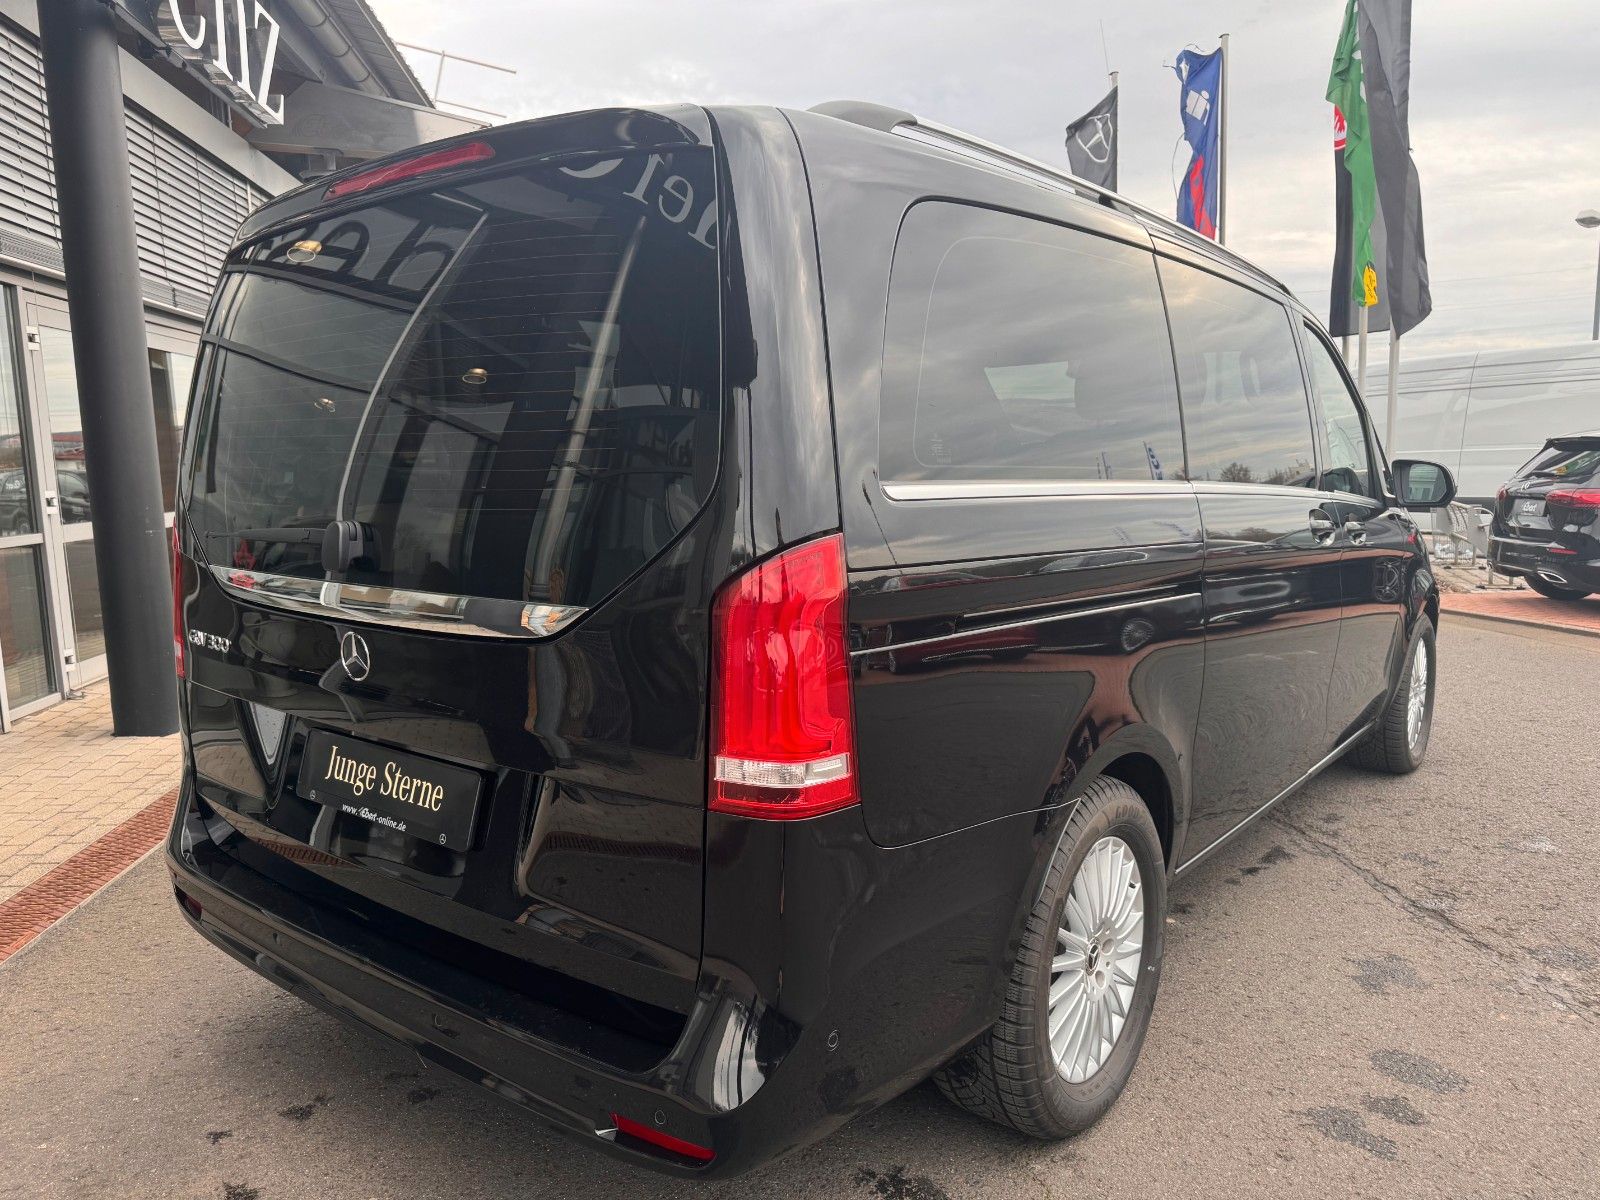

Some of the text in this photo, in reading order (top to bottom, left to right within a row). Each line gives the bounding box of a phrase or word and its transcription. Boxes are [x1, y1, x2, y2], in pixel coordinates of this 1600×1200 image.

[207, 633, 230, 653] 300
[324, 745, 444, 812] Junge Sterne
